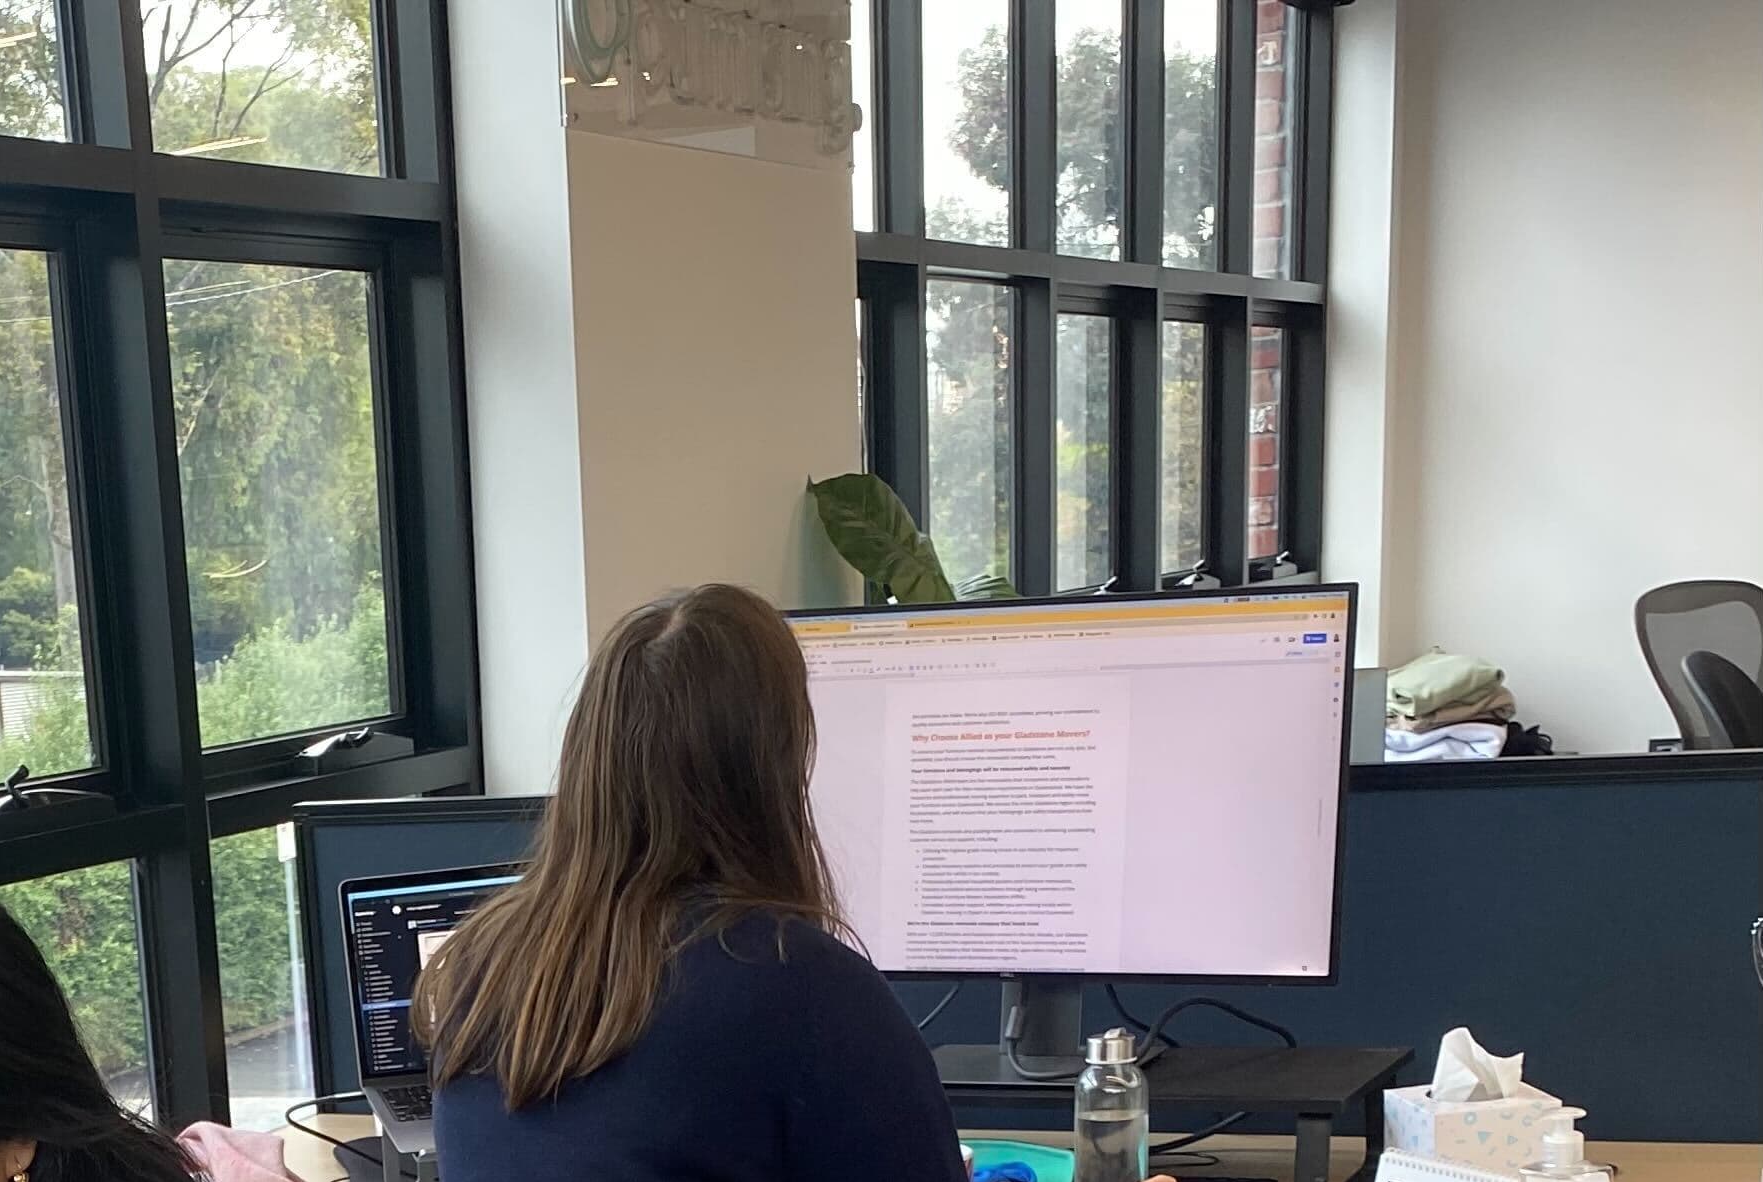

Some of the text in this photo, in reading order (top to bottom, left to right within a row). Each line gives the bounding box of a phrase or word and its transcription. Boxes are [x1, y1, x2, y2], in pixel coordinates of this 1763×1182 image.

[912, 734, 929, 744] Why
[931, 733, 959, 742] Choose
[961, 732, 983, 741] Allied
[994, 733, 1012, 743] your
[1014, 731, 1055, 740] Gladstone
[1057, 730, 1091, 739] Movers?
